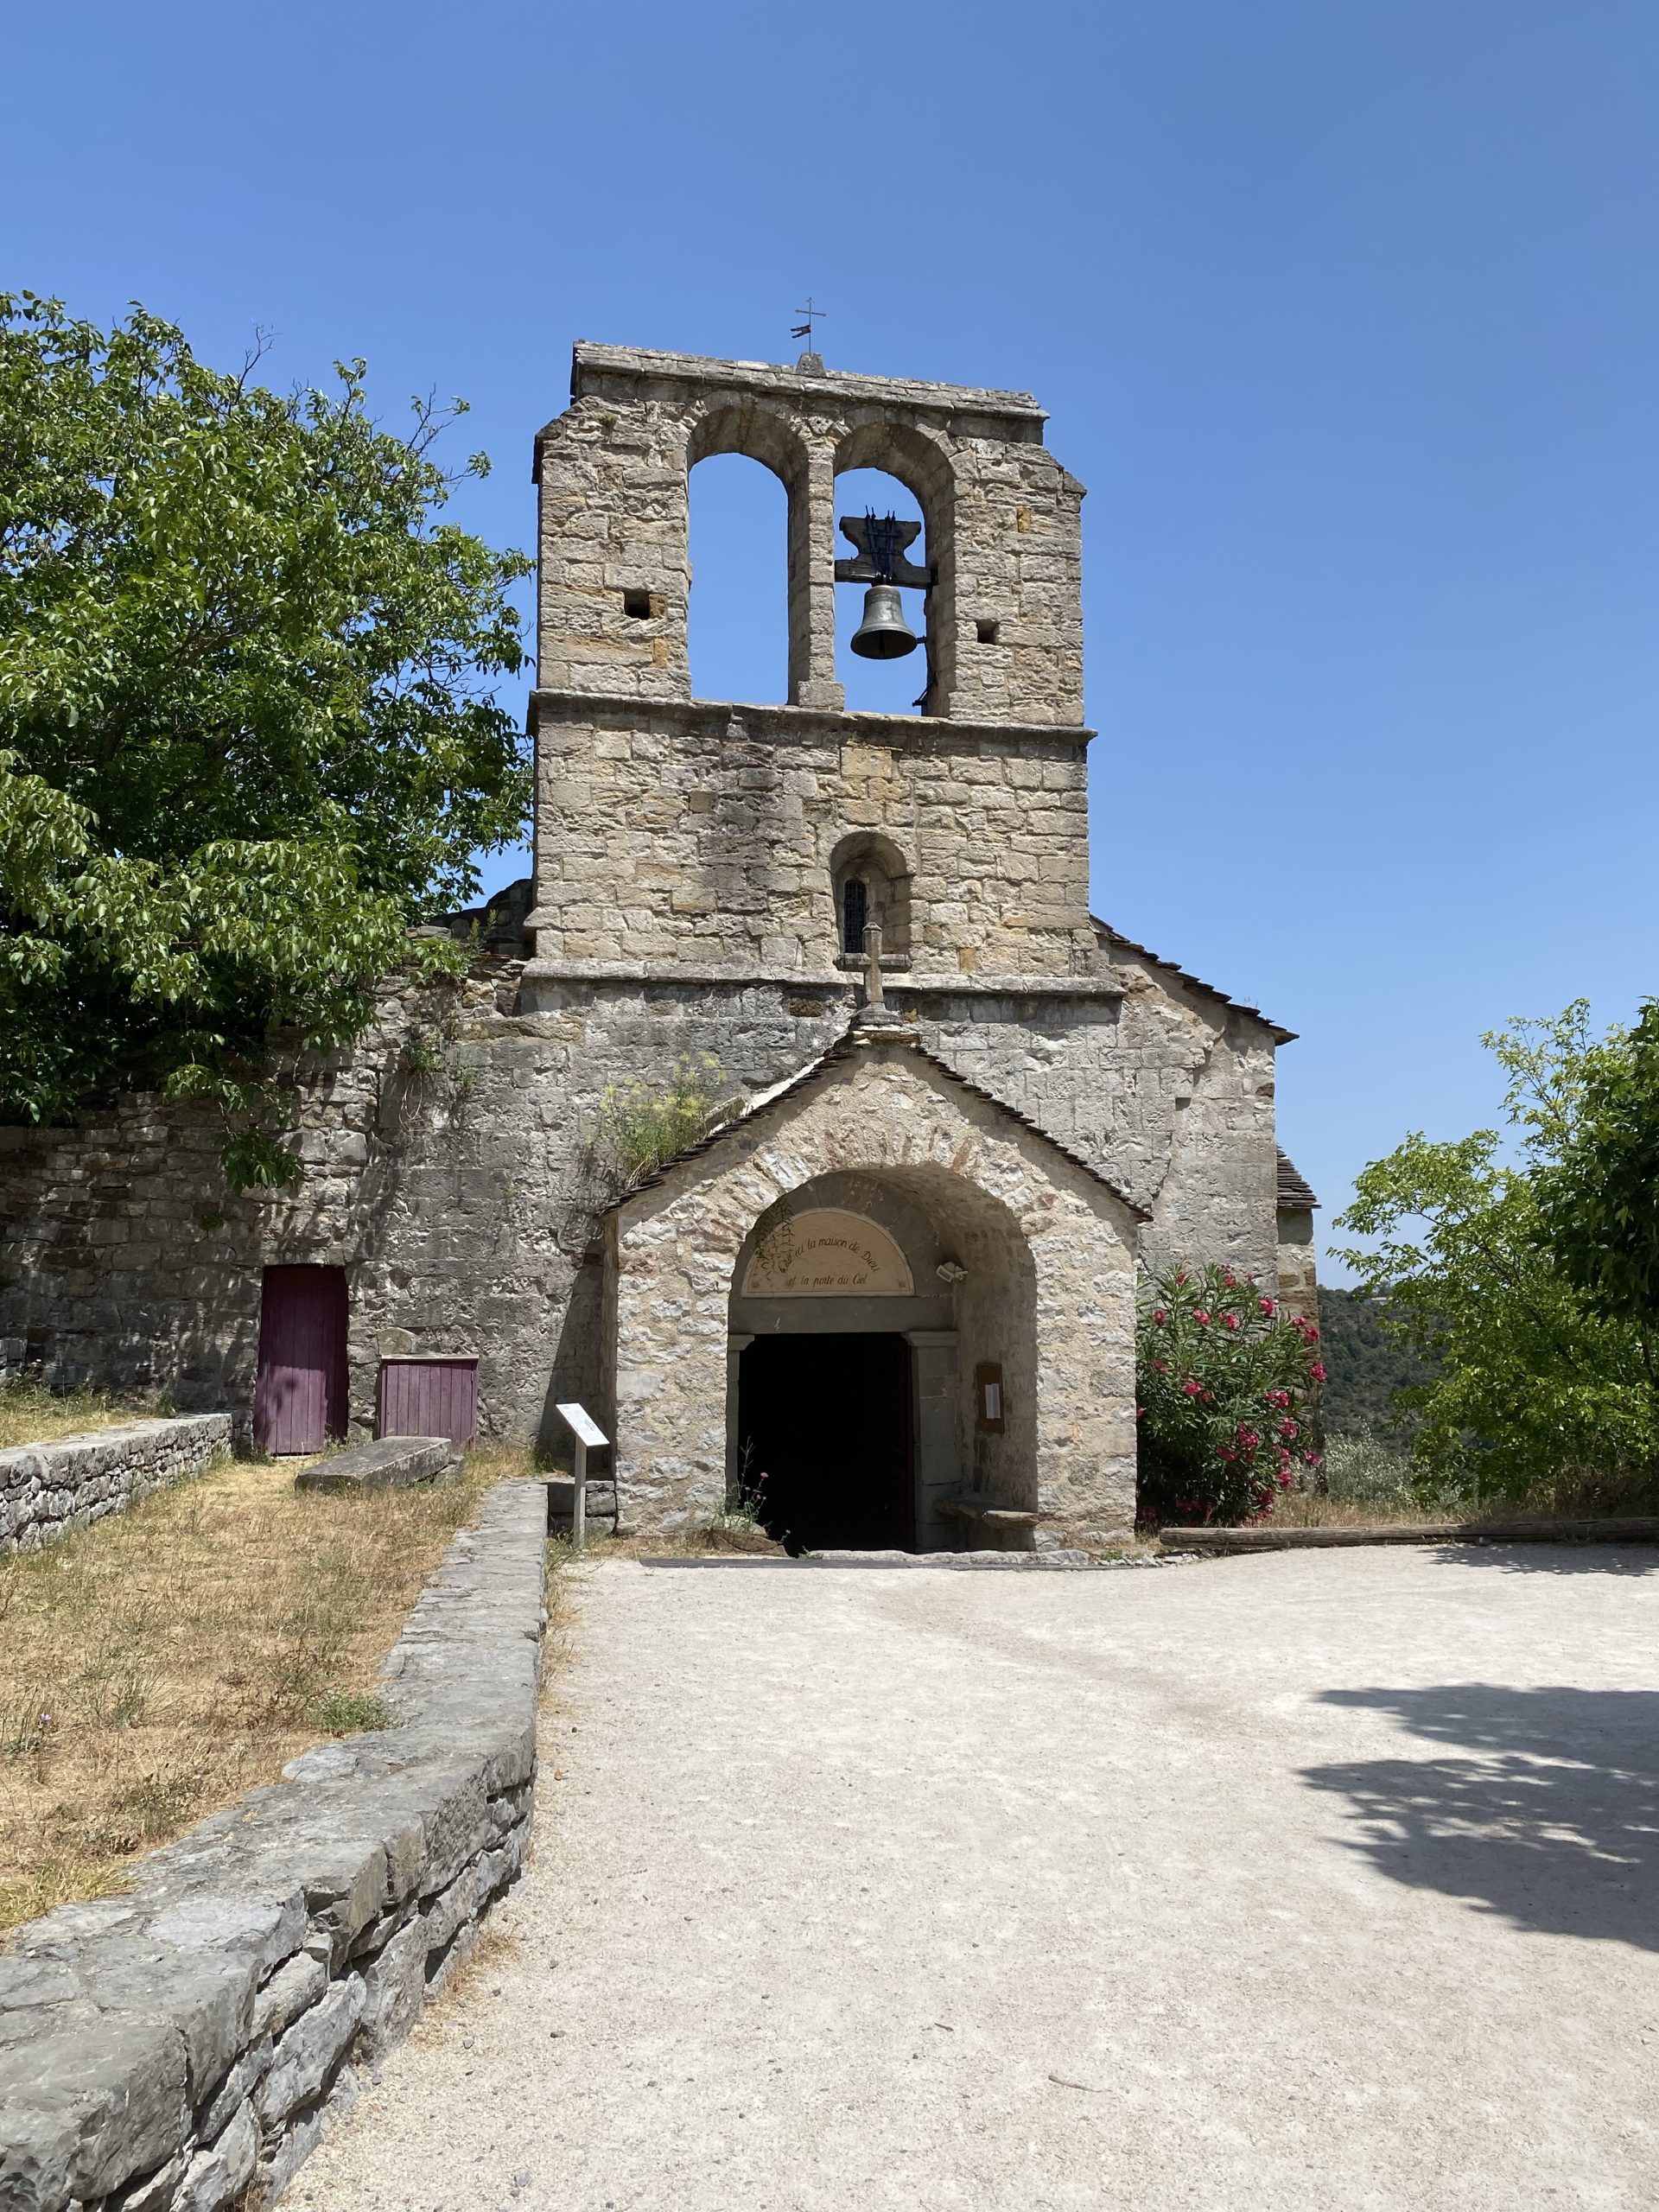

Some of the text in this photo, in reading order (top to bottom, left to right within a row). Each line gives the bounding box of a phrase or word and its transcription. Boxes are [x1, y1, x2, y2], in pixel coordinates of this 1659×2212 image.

[795, 1243, 804, 1257] ici
[807, 1238, 816, 1249] la
[818, 1237, 847, 1249] maison
[848, 1241, 861, 1254] de
[860, 1250, 880, 1272] Dieu
[800, 1275, 810, 1285] la
[813, 1274, 835, 1287] porte
[837, 1275, 849, 1285] du
[853, 1273, 868, 1285] Ciel
